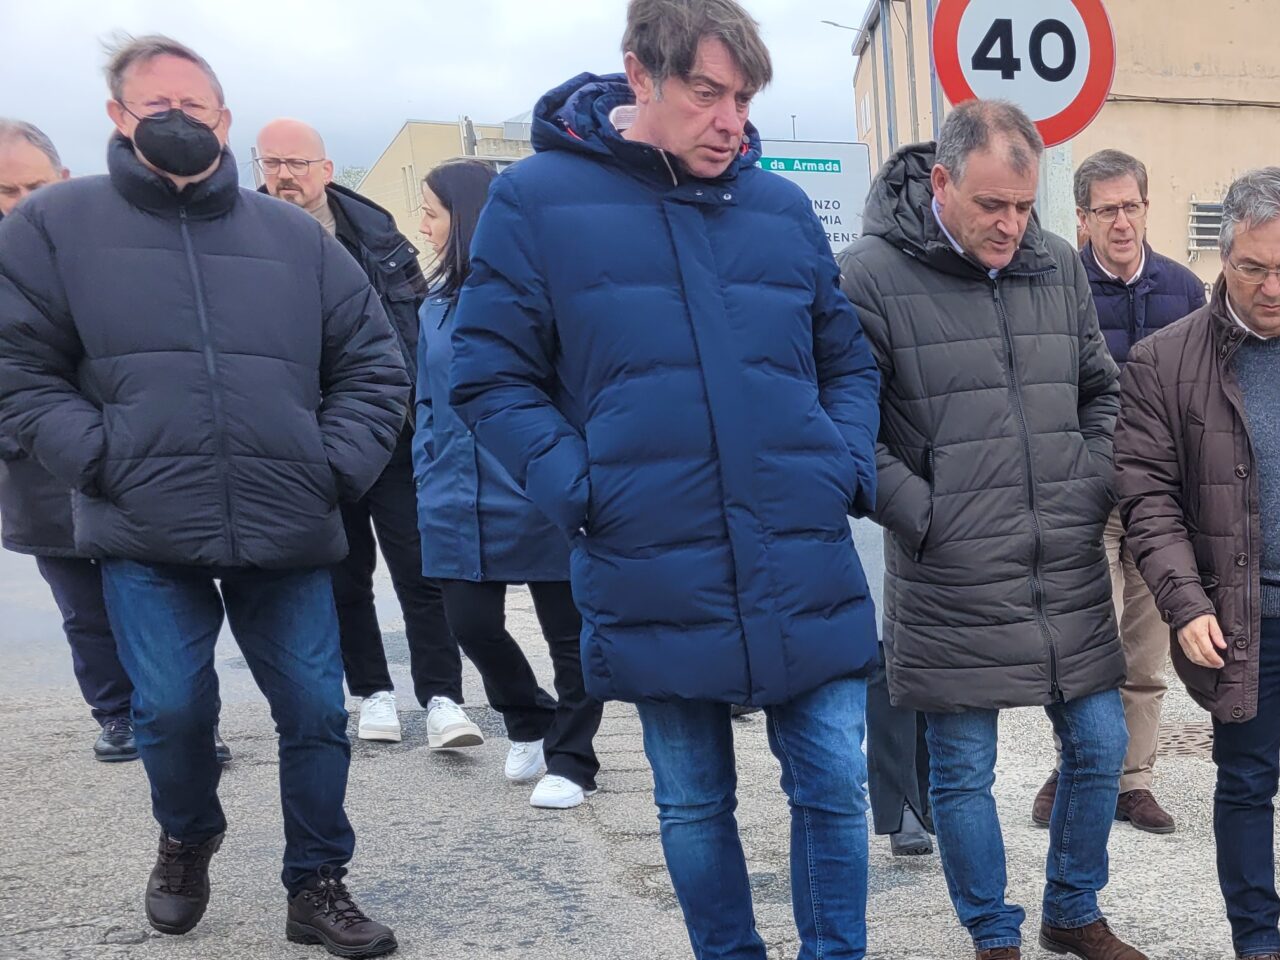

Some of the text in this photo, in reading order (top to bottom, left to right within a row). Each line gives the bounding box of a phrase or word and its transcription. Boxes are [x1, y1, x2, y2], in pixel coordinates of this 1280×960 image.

[971, 18, 1076, 82] 40
[770, 159, 785, 169] da
[793, 160, 840, 172] Armada
[814, 200, 841, 210] NZO
[819, 215, 842, 225] MIA
[825, 232, 858, 242] RENS
